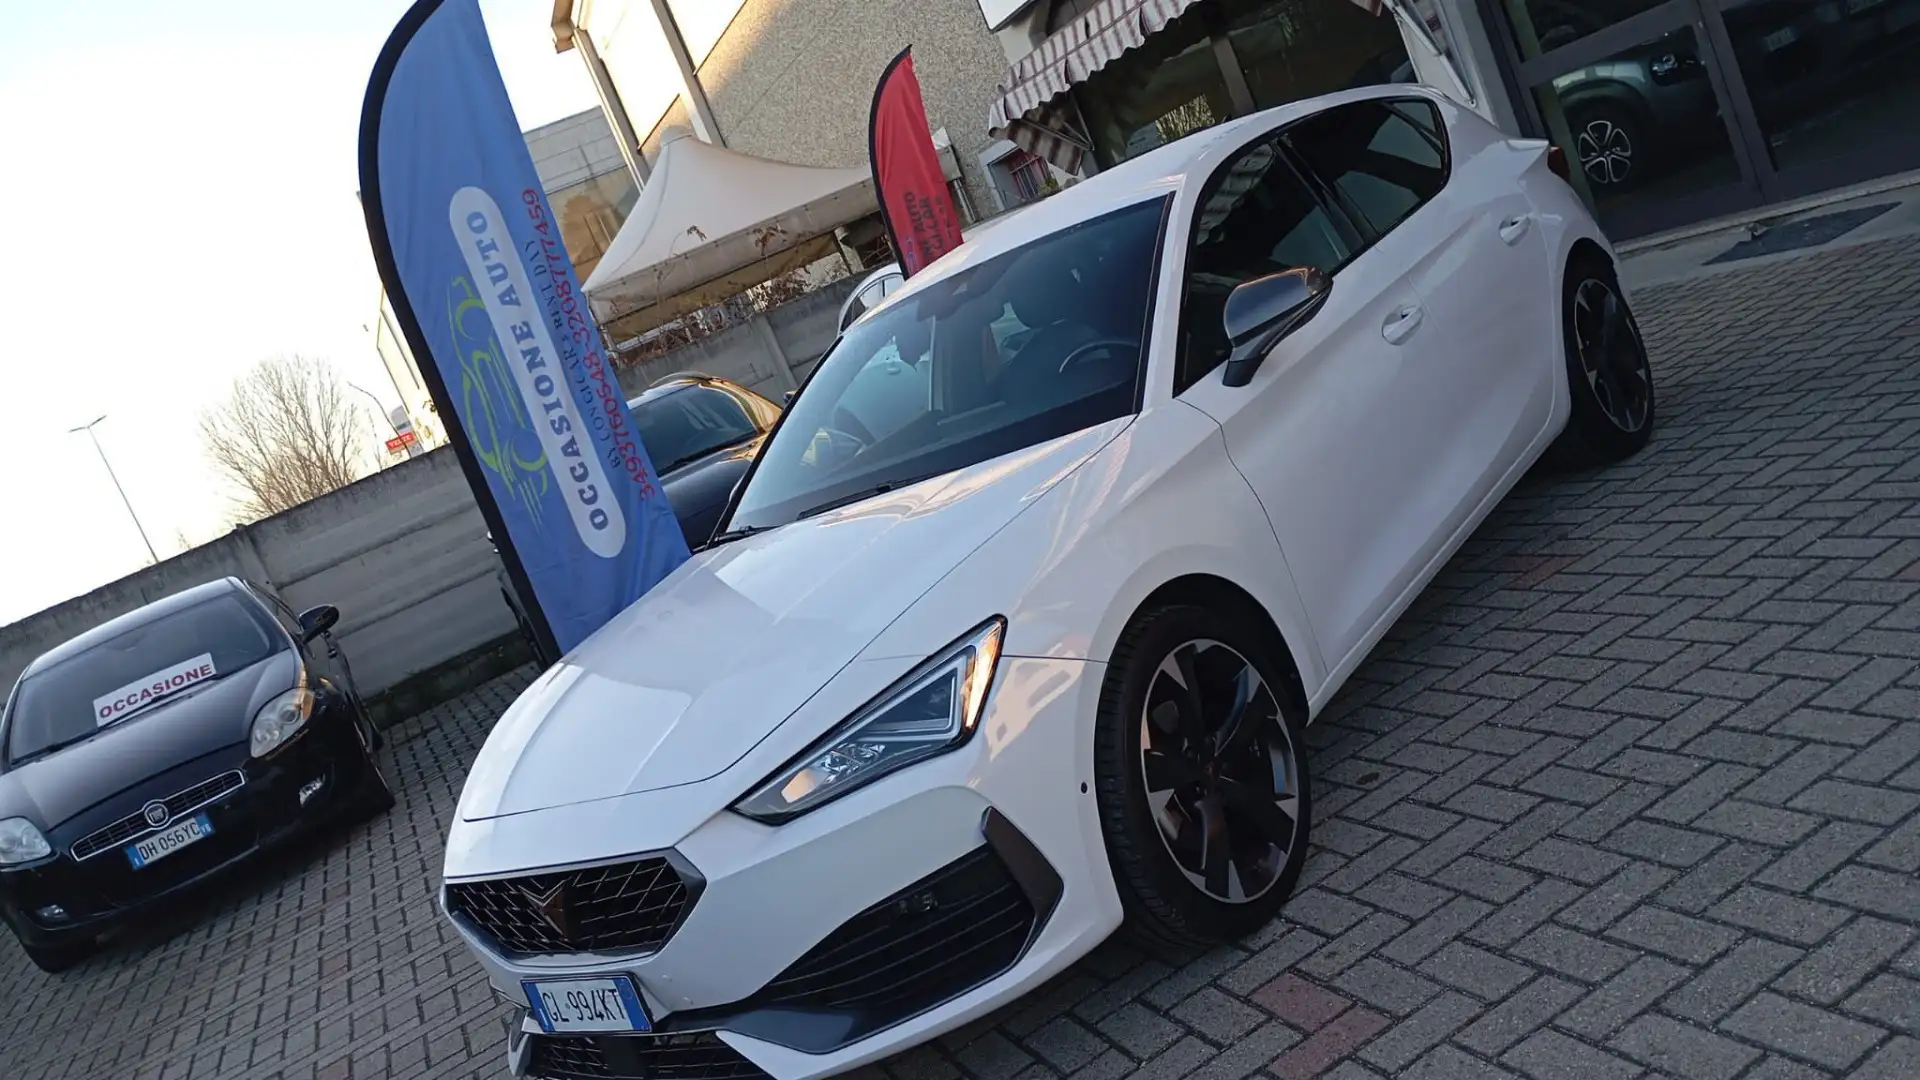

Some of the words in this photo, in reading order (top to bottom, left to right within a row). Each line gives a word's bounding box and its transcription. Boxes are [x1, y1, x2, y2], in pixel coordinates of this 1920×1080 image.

[466, 211, 521, 306] AUTO
[511, 320, 609, 531] OCCASIONE
[99, 663, 213, 719] OCCASIONE
[138, 841, 159, 861] DH
[158, 821, 201, 851] 056YC
[541, 990, 570, 1023] GL
[567, 988, 627, 1022] 994KT
